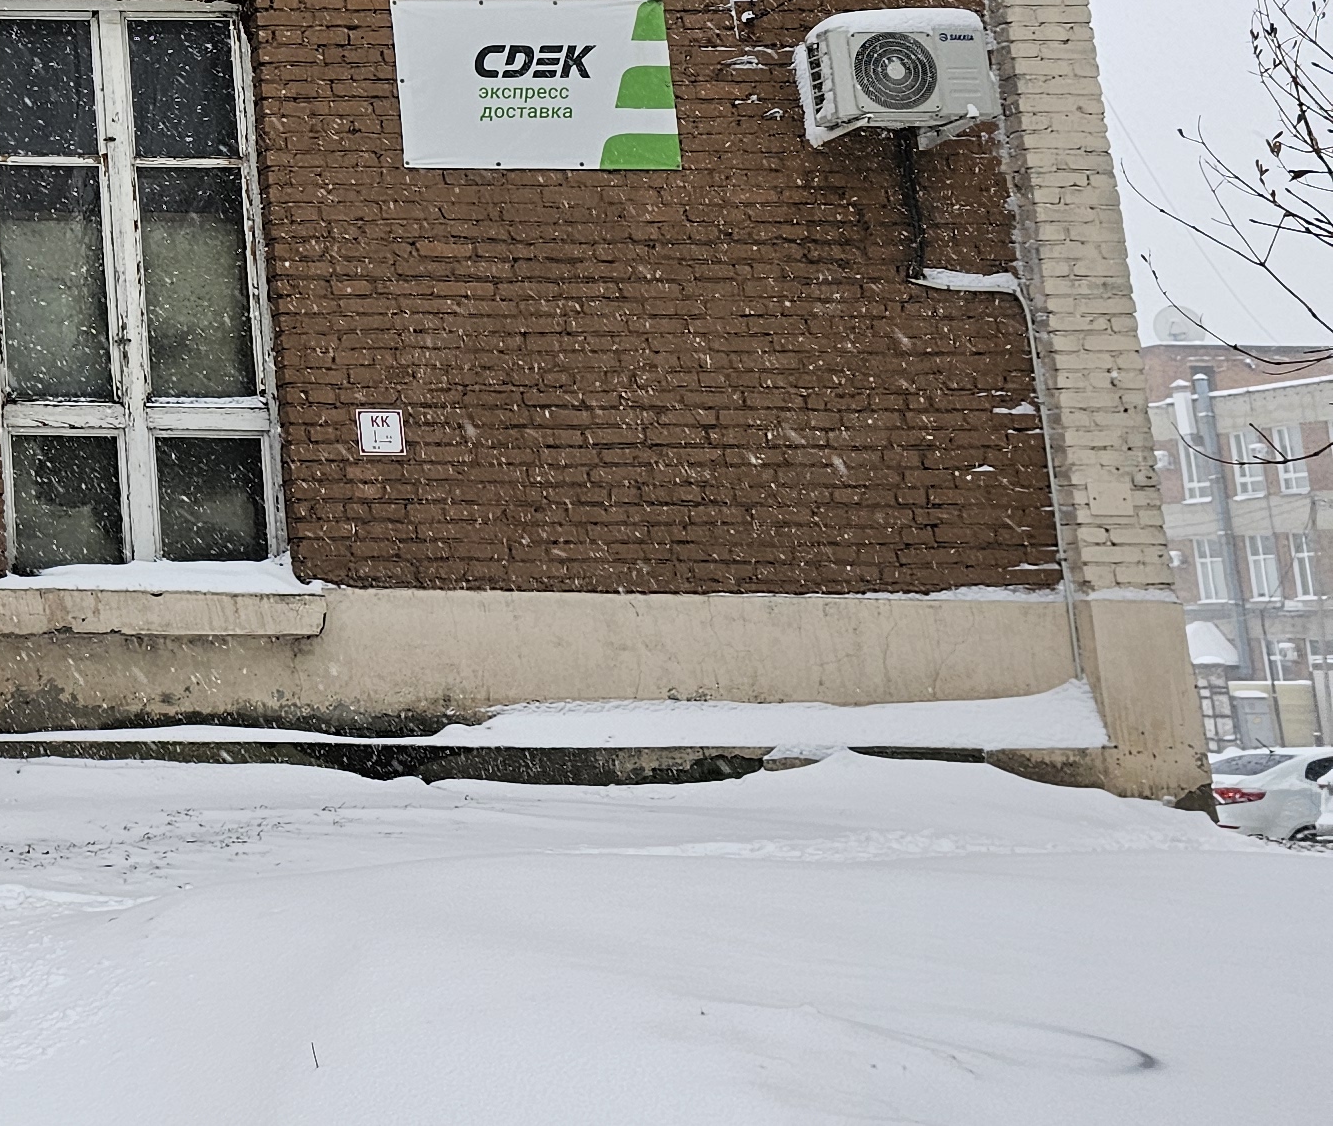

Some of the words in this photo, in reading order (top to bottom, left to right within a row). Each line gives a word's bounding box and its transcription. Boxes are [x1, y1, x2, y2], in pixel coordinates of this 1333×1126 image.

[474, 44, 597, 79] CDEK
[478, 87, 570, 103] экспресс
[479, 106, 573, 121] доставка
